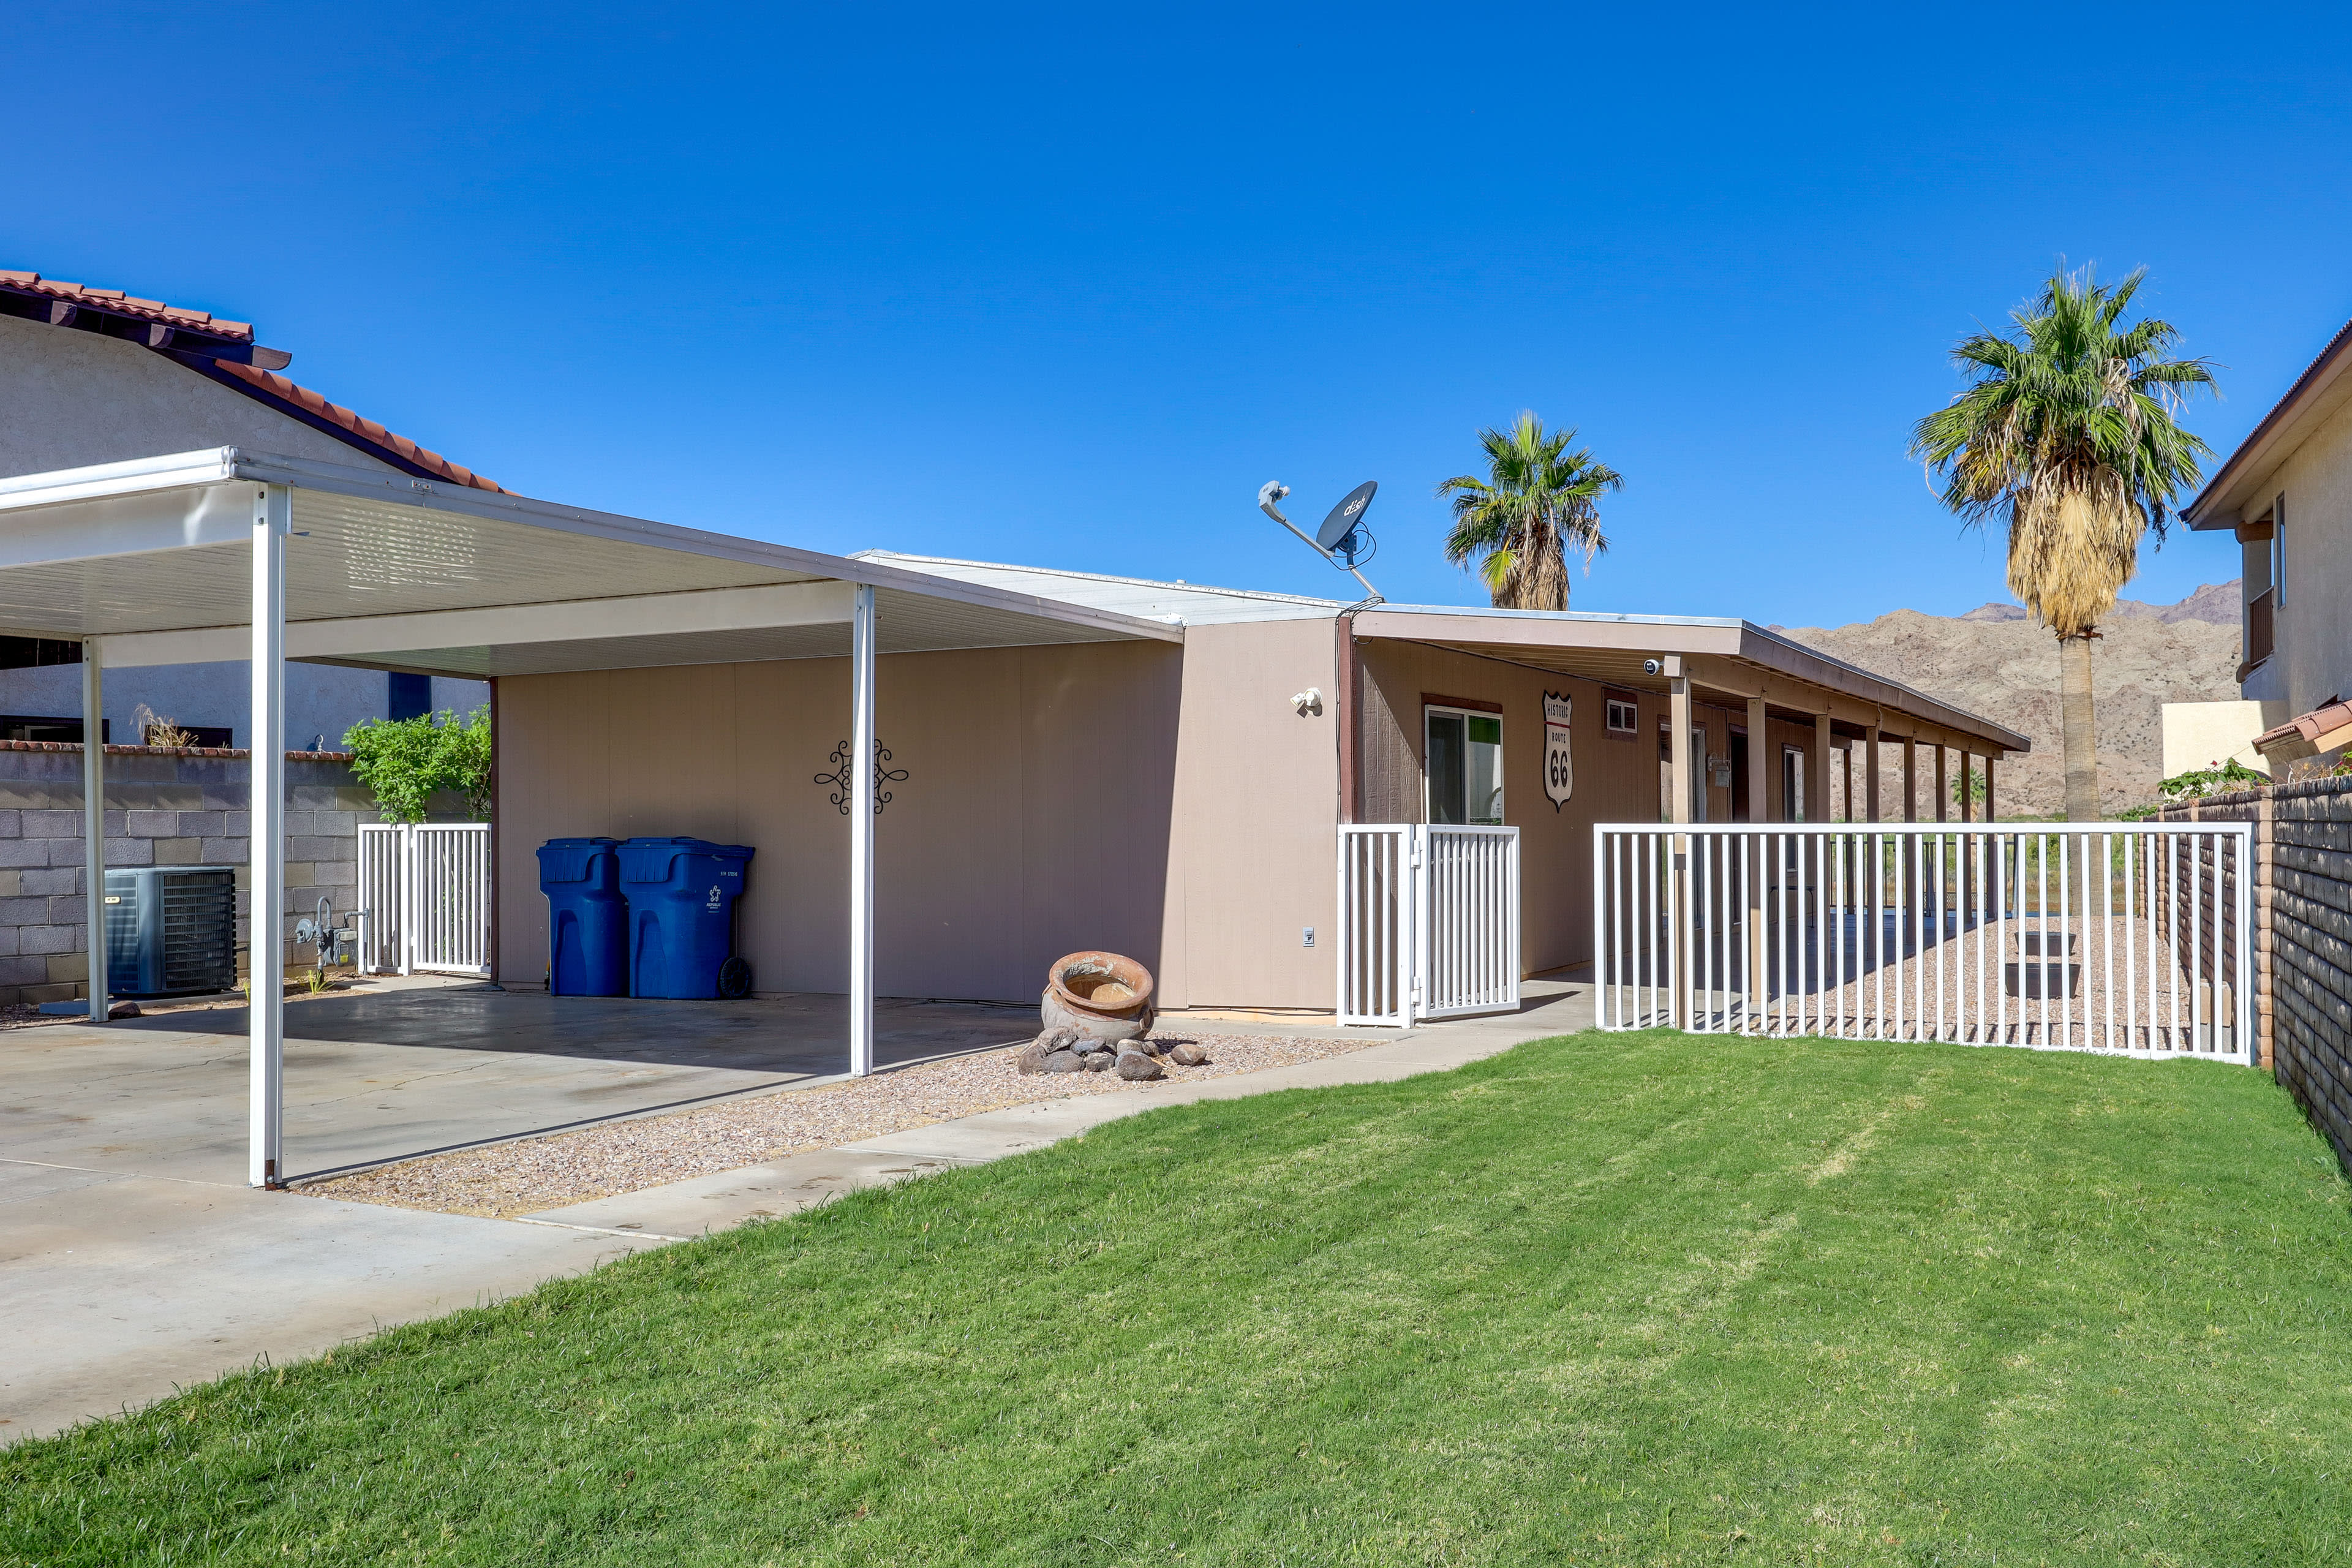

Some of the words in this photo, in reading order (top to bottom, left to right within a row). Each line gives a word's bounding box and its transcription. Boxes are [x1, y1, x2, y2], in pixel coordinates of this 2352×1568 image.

[1344, 495, 1366, 516] dish
[1547, 703, 1569, 718] HISTORIC
[1551, 731, 1566, 744] ROUTE
[1550, 749, 1568, 788] 66
